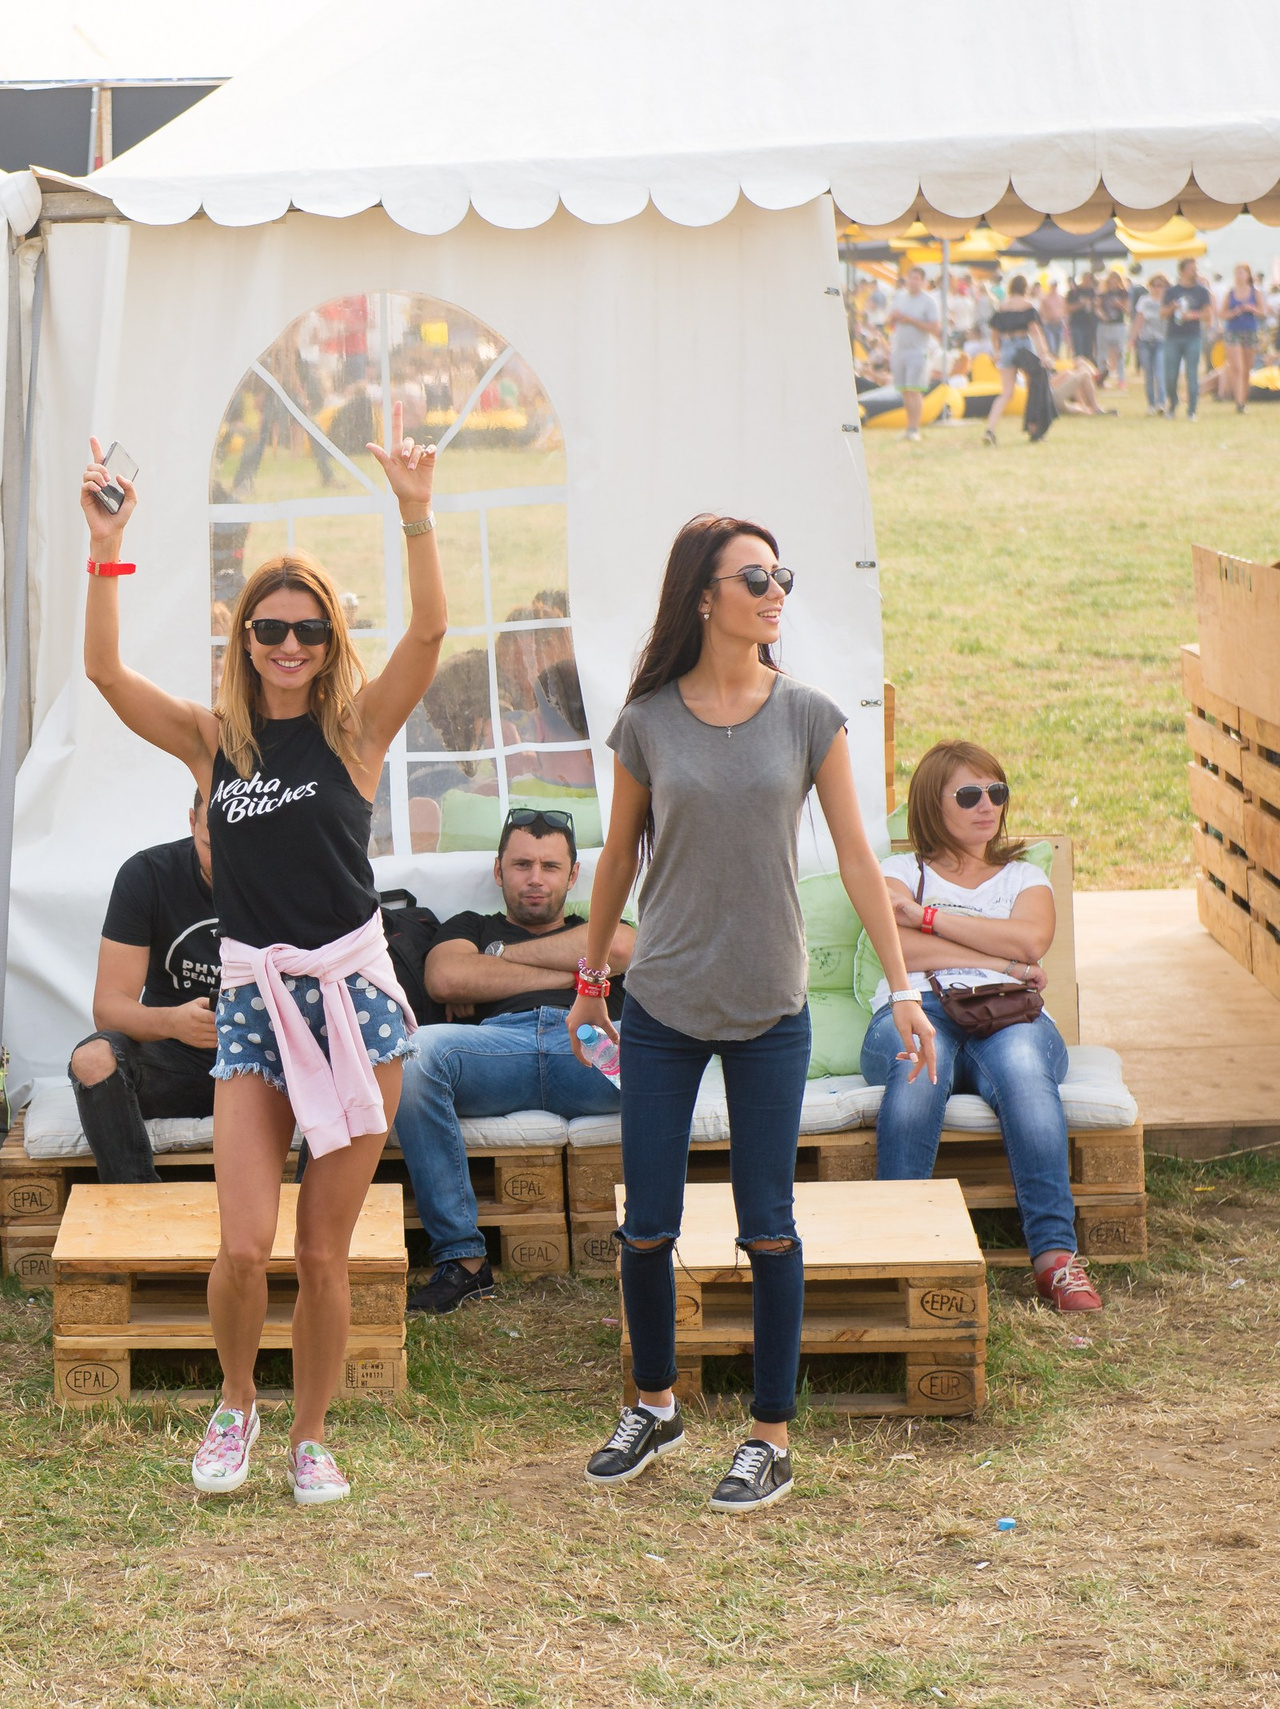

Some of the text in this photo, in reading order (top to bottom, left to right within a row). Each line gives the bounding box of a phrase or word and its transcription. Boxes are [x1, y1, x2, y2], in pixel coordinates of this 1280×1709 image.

[210, 771, 281, 809] Aloha
[222, 781, 318, 823] Bitches
[182, 969, 216, 985] DEAN
[511, 1180, 545, 1196] EPAL
[13, 1191, 48, 1208] EPAL
[520, 1247, 553, 1262] EPAL
[590, 1240, 619, 1256] EPA
[931, 1294, 967, 1313] EPAL
[73, 1370, 110, 1388] EPAL
[930, 1376, 960, 1396] EUR
